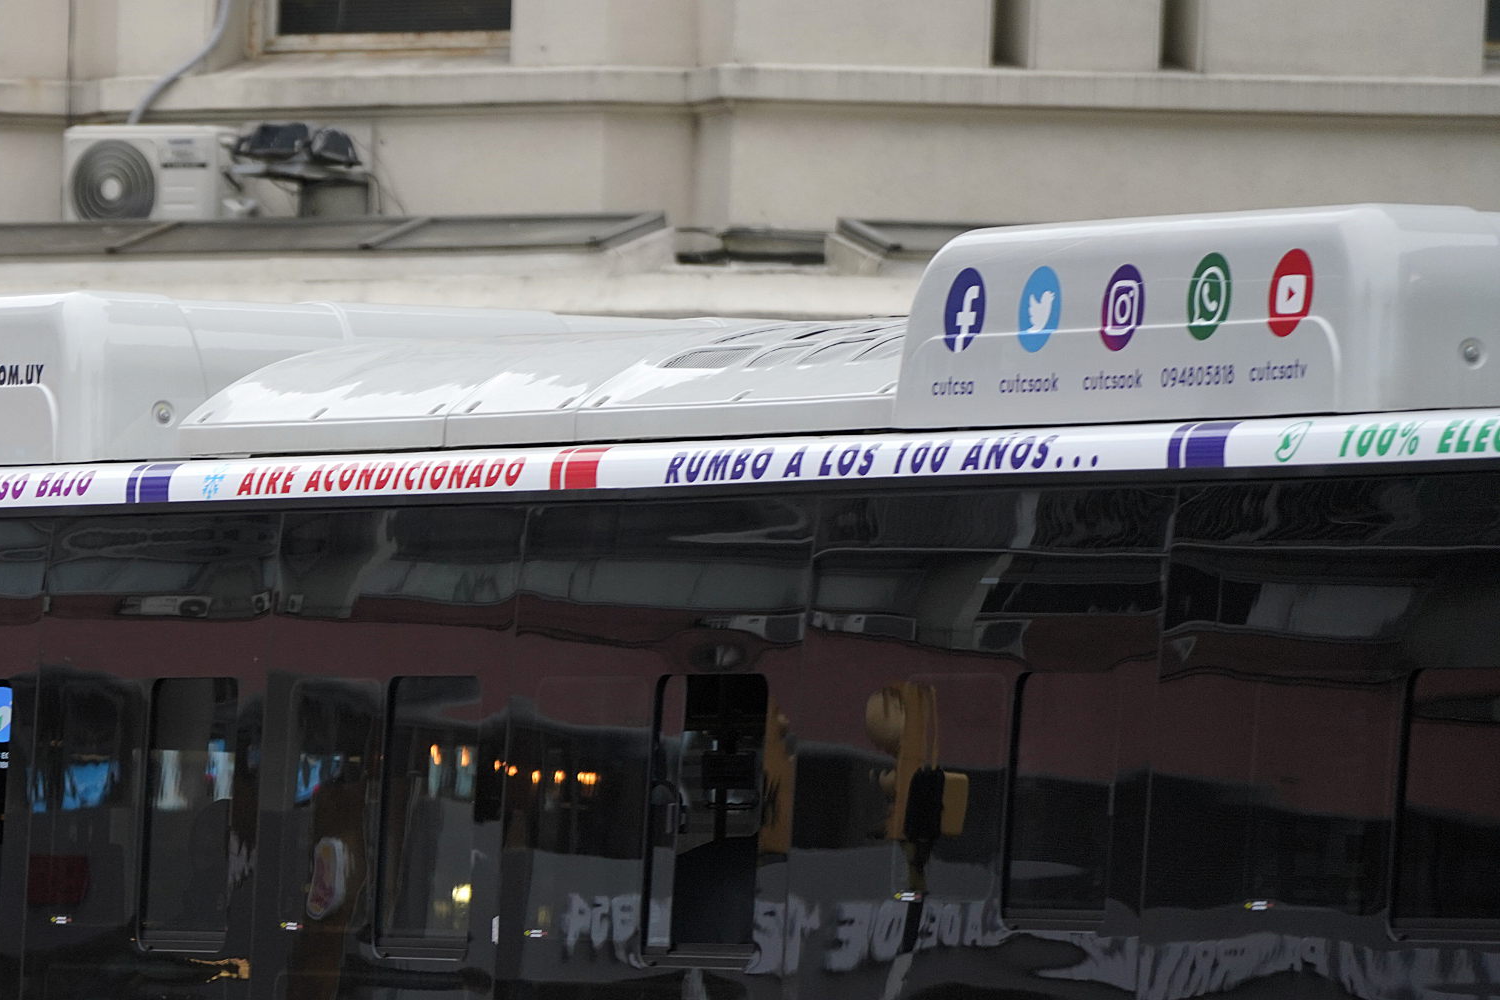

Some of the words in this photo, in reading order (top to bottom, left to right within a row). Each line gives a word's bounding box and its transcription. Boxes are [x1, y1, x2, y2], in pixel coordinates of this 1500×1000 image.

[1082, 368, 1143, 391] cutcsaok
[1249, 358, 1308, 382] cutcsatv
[931, 376, 975, 396] cutcsa
[999, 373, 1059, 394] cutcsaok
[1338, 420, 1428, 458] 100%
[664, 447, 775, 484] RUMBO
[782, 446, 809, 478] A
[818, 443, 884, 477] LOS
[893, 440, 953, 474] 100
[35, 470, 97, 498] BAJO
[237, 465, 301, 496] AIRE
[303, 456, 527, 493] ACONDICIONADO
